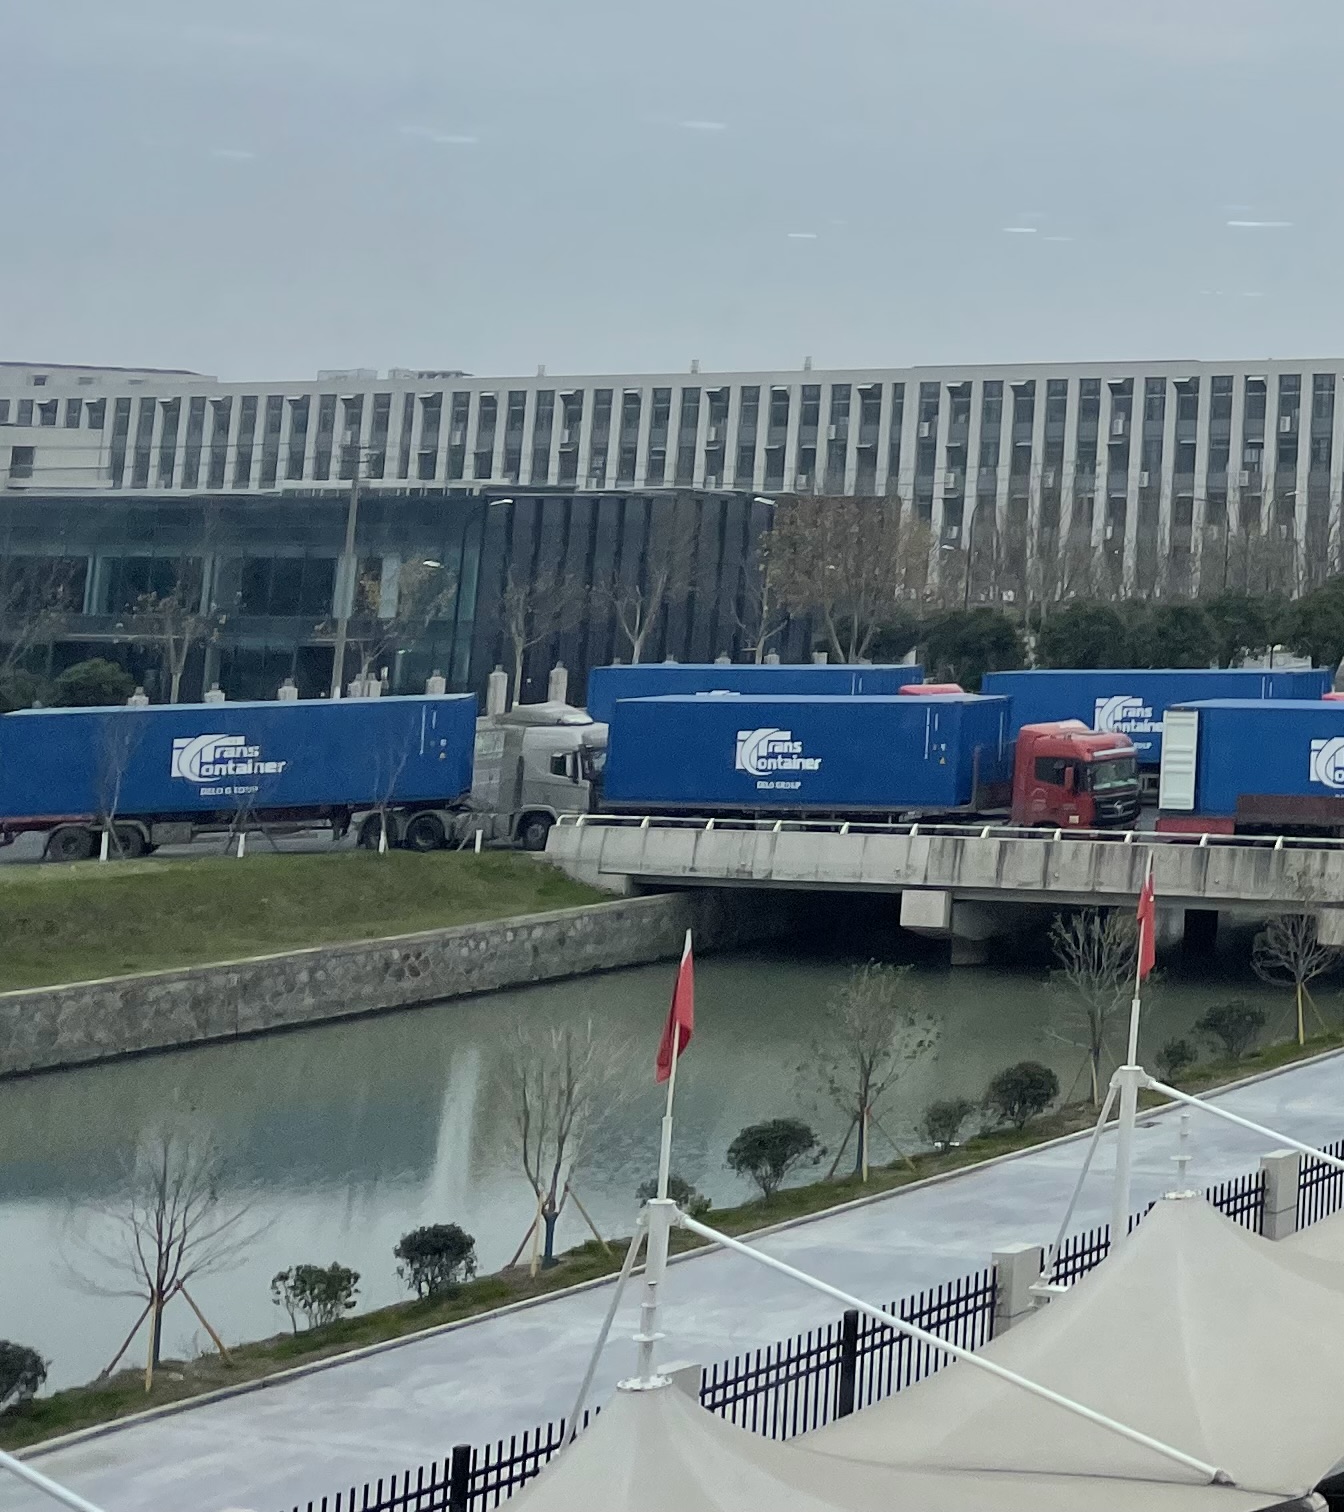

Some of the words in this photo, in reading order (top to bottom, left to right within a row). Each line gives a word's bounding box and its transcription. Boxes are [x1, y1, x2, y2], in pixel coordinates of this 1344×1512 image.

[1113, 698, 1153, 721] Trans
[201, 736, 260, 762] Trans
[757, 730, 804, 756] Trans
